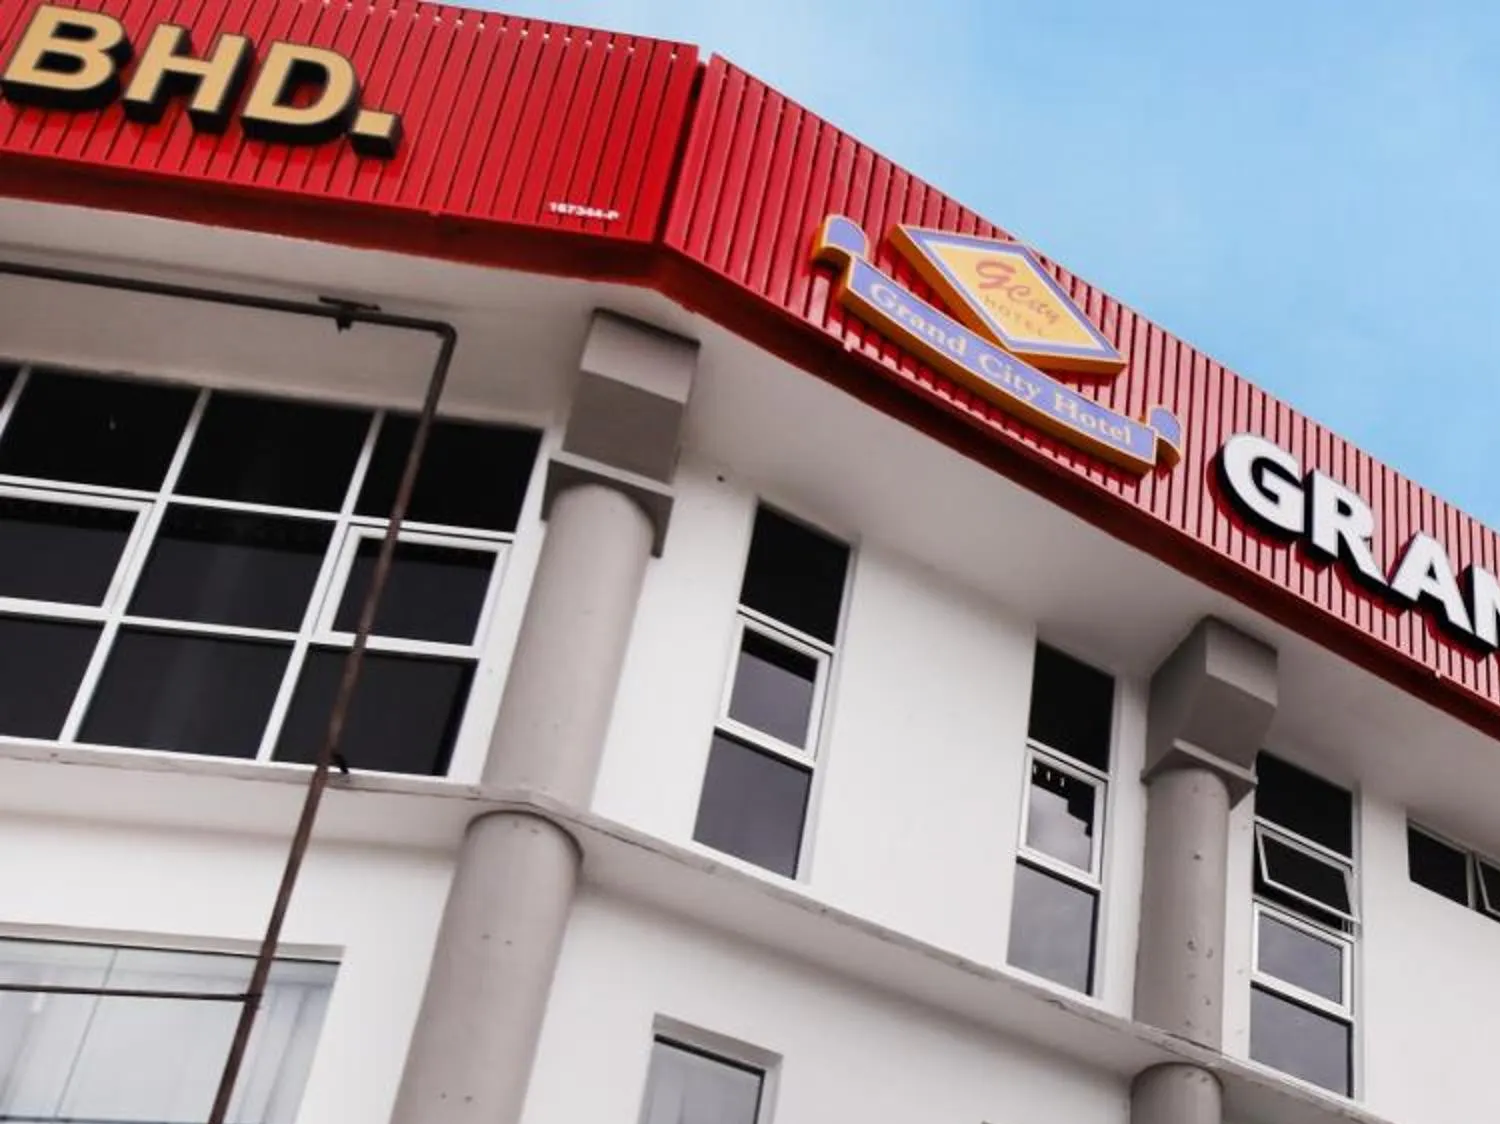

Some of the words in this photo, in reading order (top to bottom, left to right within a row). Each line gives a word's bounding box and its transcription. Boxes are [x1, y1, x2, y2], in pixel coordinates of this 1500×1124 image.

[2, 4, 403, 152] BHD.
[870, 282, 967, 354] Grand
[978, 352, 1042, 400] City
[1054, 390, 1132, 445] Hotel
